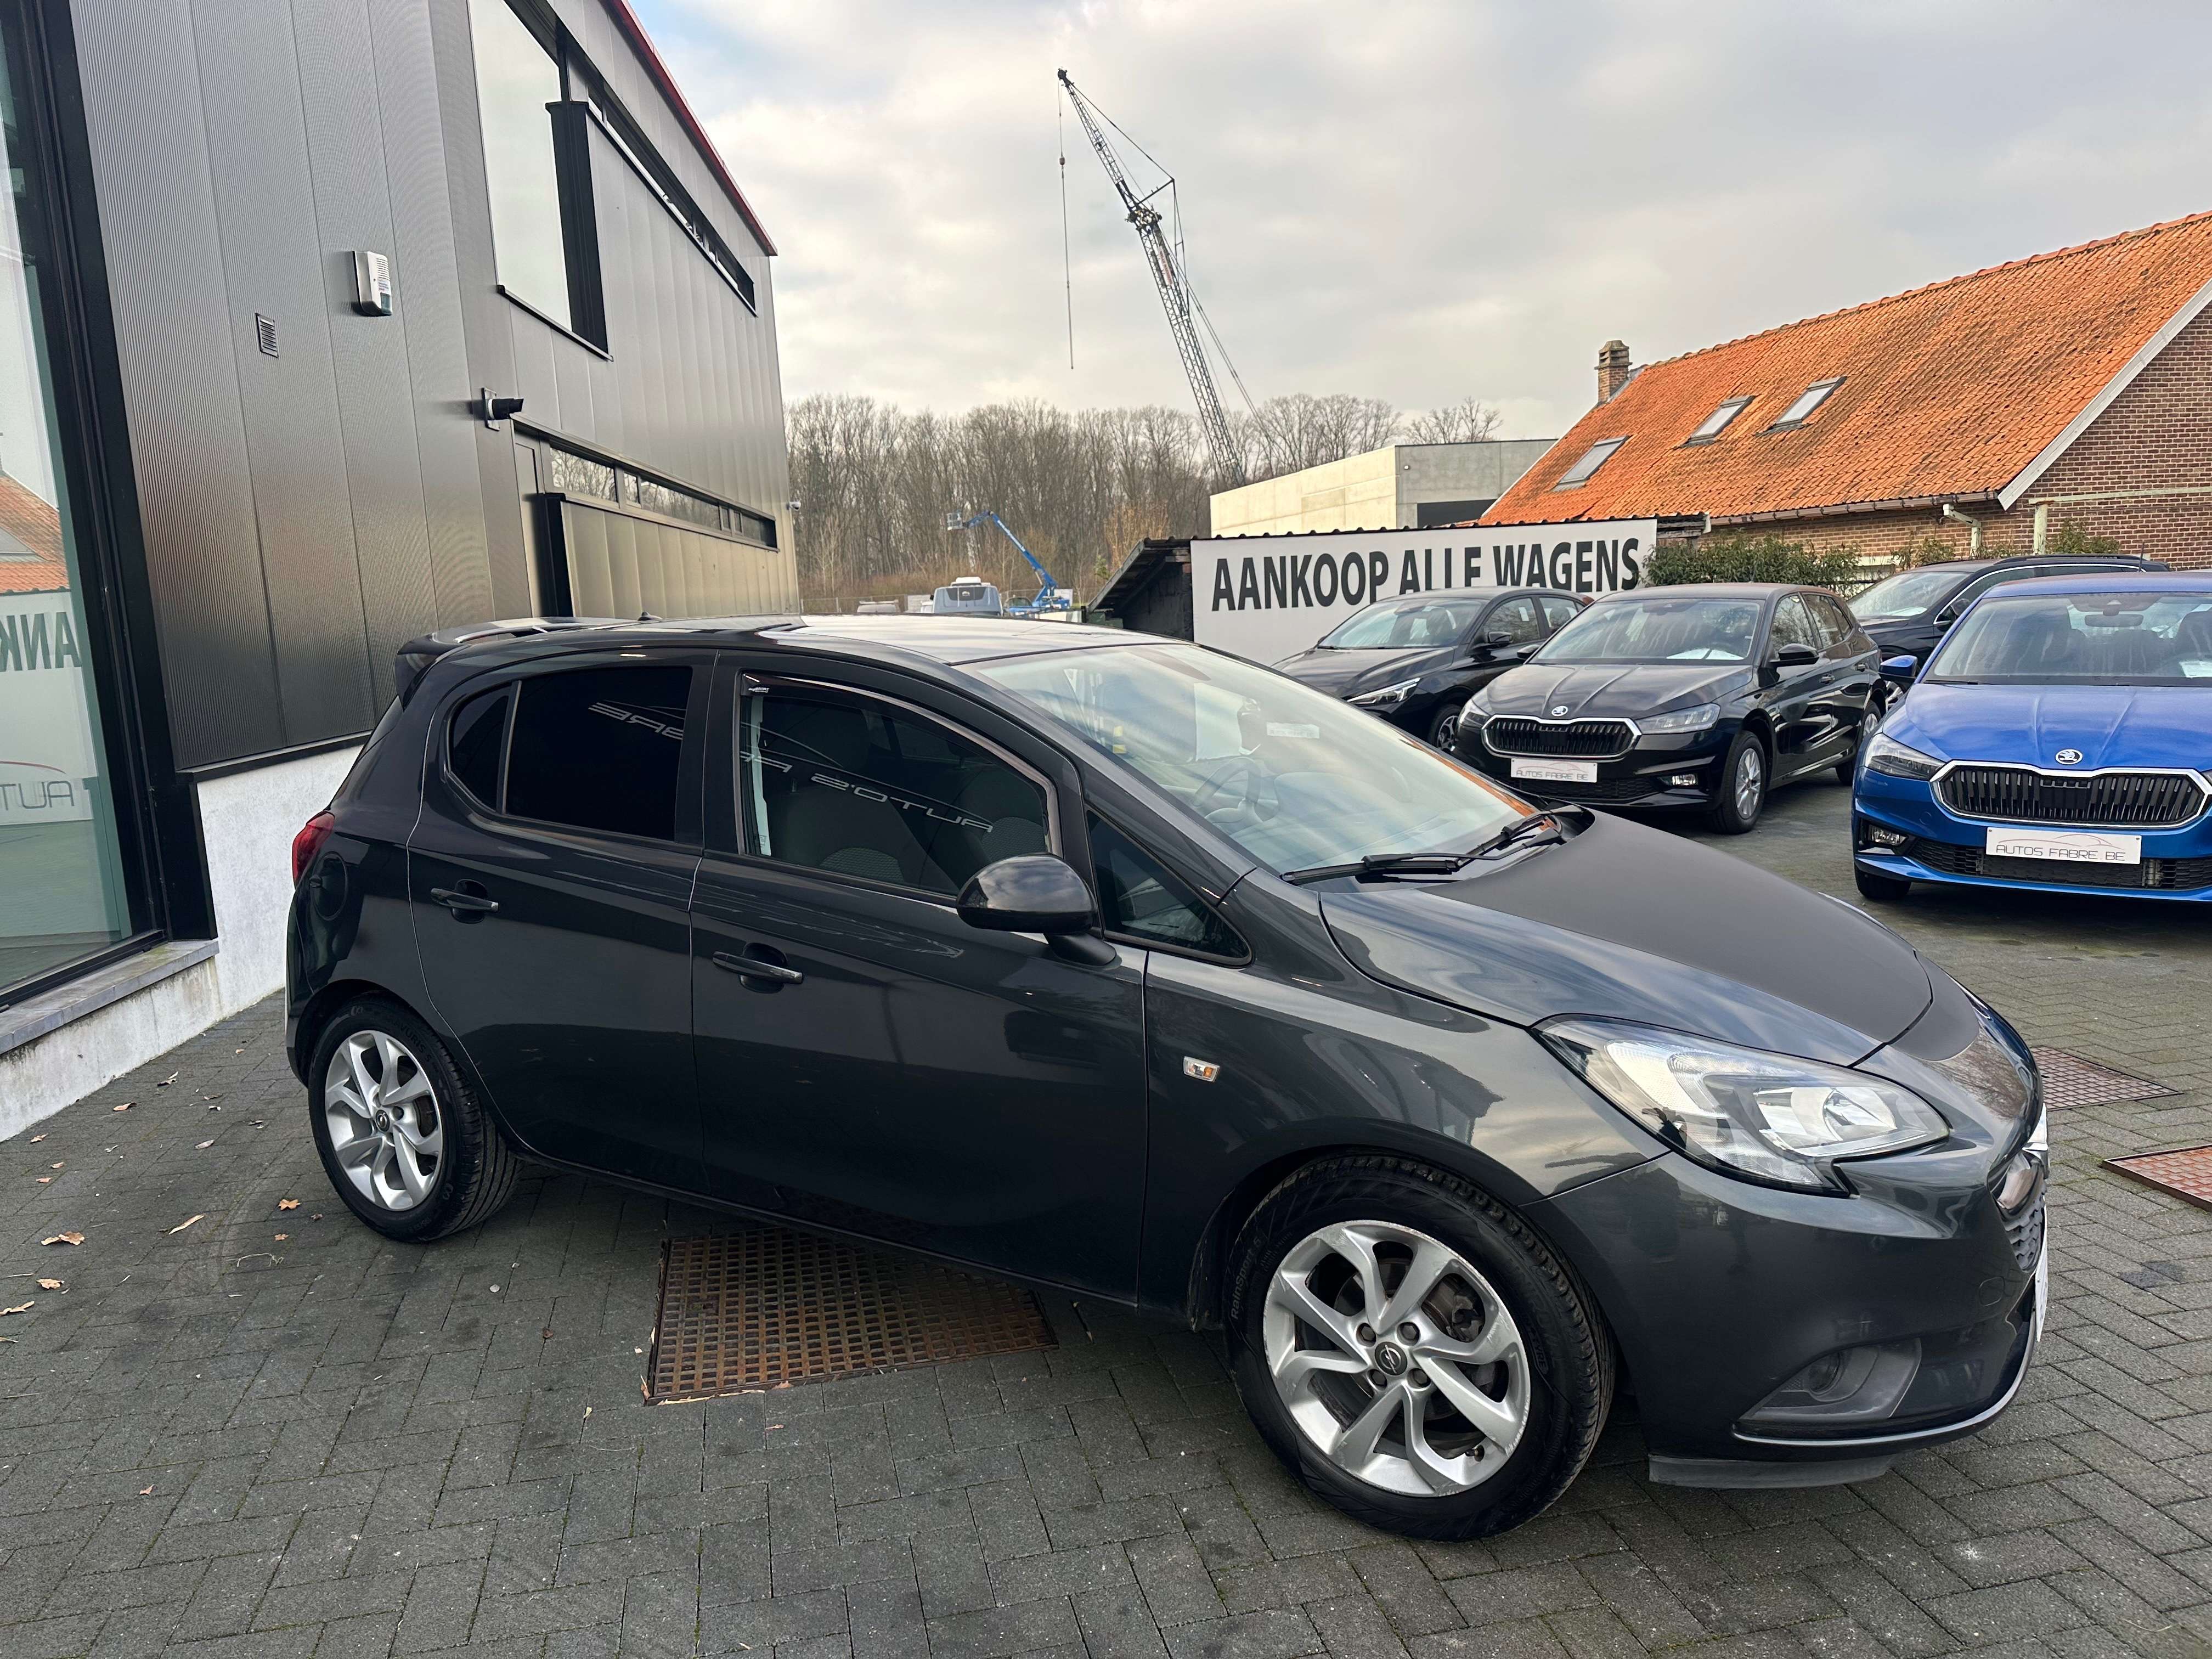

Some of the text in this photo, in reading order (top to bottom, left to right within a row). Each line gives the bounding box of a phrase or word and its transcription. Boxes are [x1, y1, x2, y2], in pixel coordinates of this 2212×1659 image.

[1212, 551, 1389, 612] AANKOOP
[1493, 538, 1639, 593] WAGENS
[1516, 770, 1543, 778] AUTOS
[1545, 771, 1573, 780] FABRE
[1996, 844, 2044, 856] AUTOS
[2049, 848, 2098, 860] FABRE
